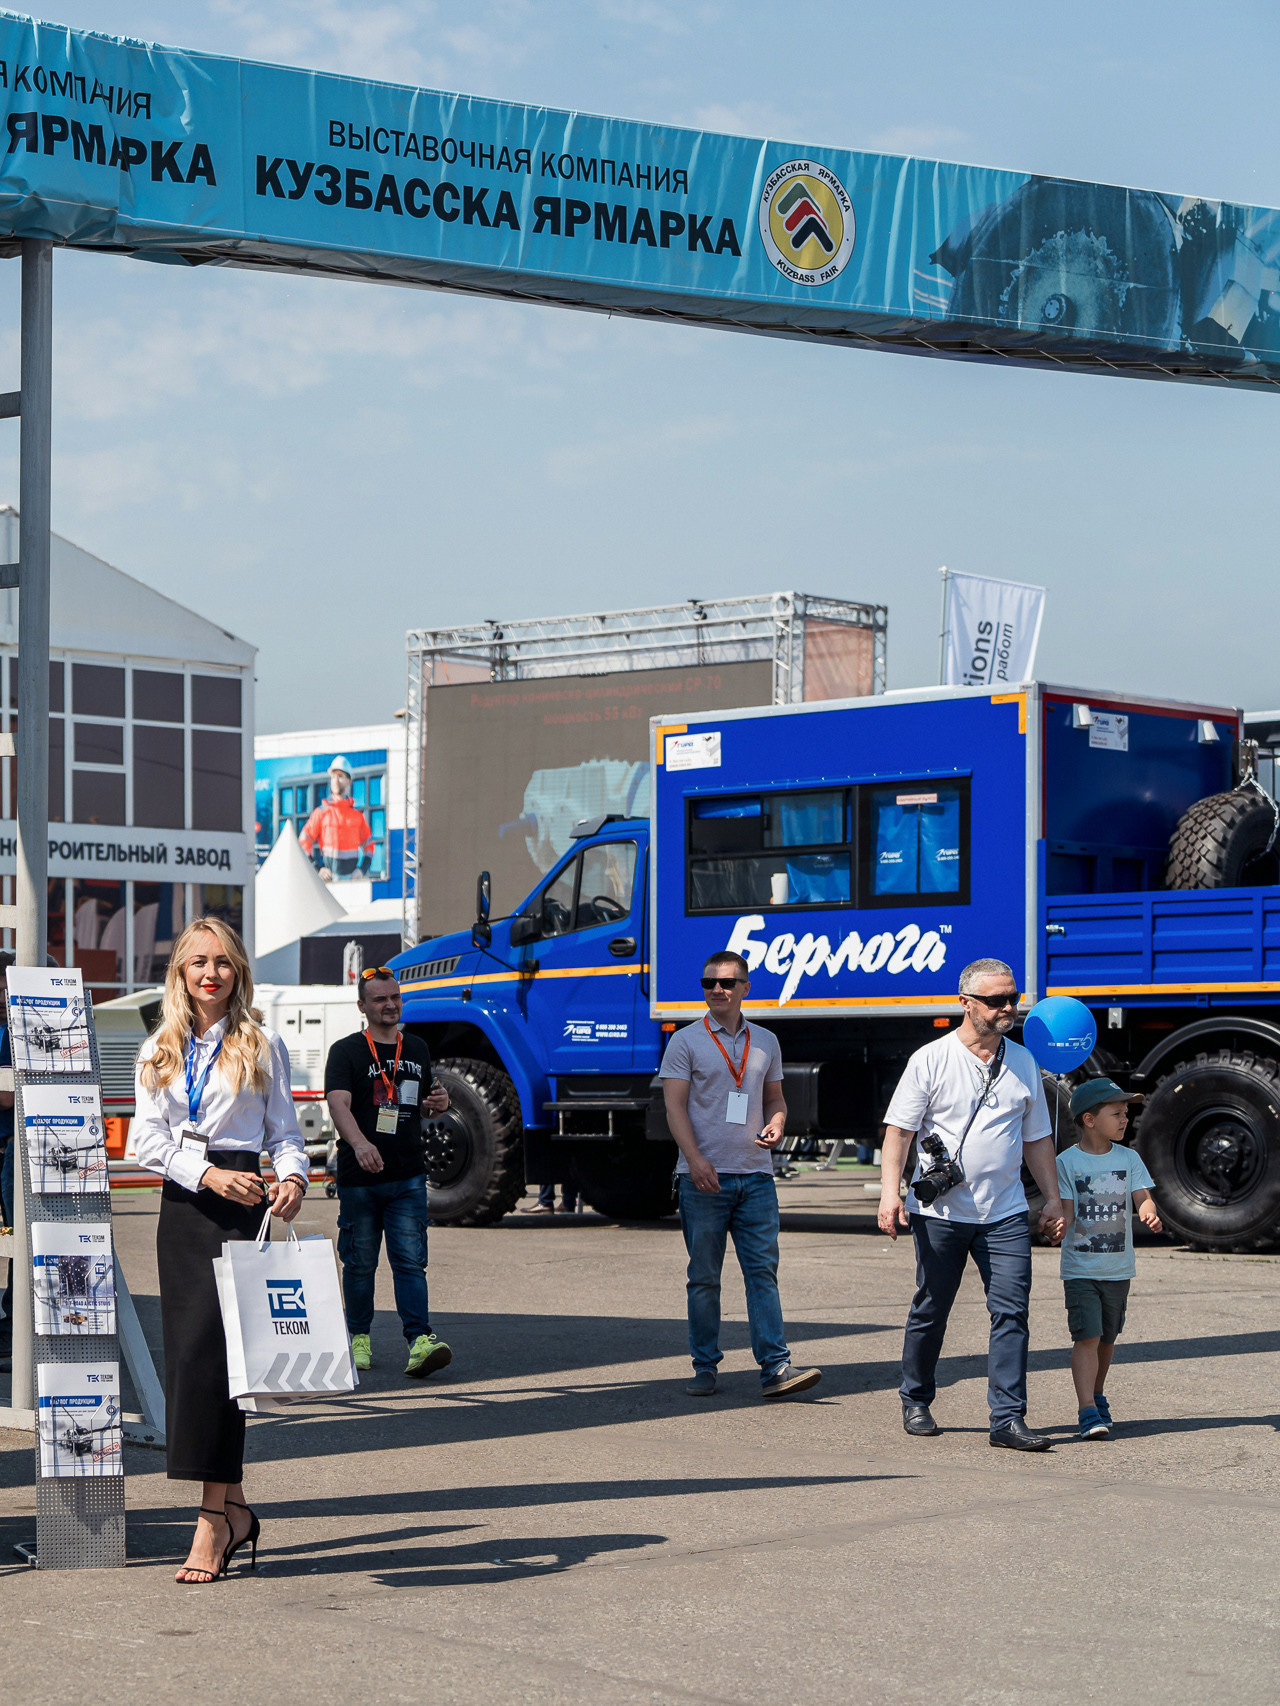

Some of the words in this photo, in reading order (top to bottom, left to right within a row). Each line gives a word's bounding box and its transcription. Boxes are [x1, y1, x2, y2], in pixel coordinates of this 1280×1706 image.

[15, 63, 152, 120] КОМПАНИЯ
[328, 120, 532, 175] ВЫСТАВОЧНАЯ
[540, 151, 690, 195] КОМПАНИЯ
[256, 155, 521, 231] КУЗБАССКА
[532, 195, 742, 257] ЯРМАРКА
[762, 163, 810, 203] КУЗБАССКАЯ
[818, 168, 851, 213] ЯРМАРКА
[776, 258, 815, 283] KUZBASS
[820, 265, 839, 281] FAIR
[174, 847, 232, 871] ЗАВОД
[723, 914, 947, 1008] Берлога
[1086, 1205, 1118, 1213] FEAR
[272, 1320, 311, 1335] TEKOM
